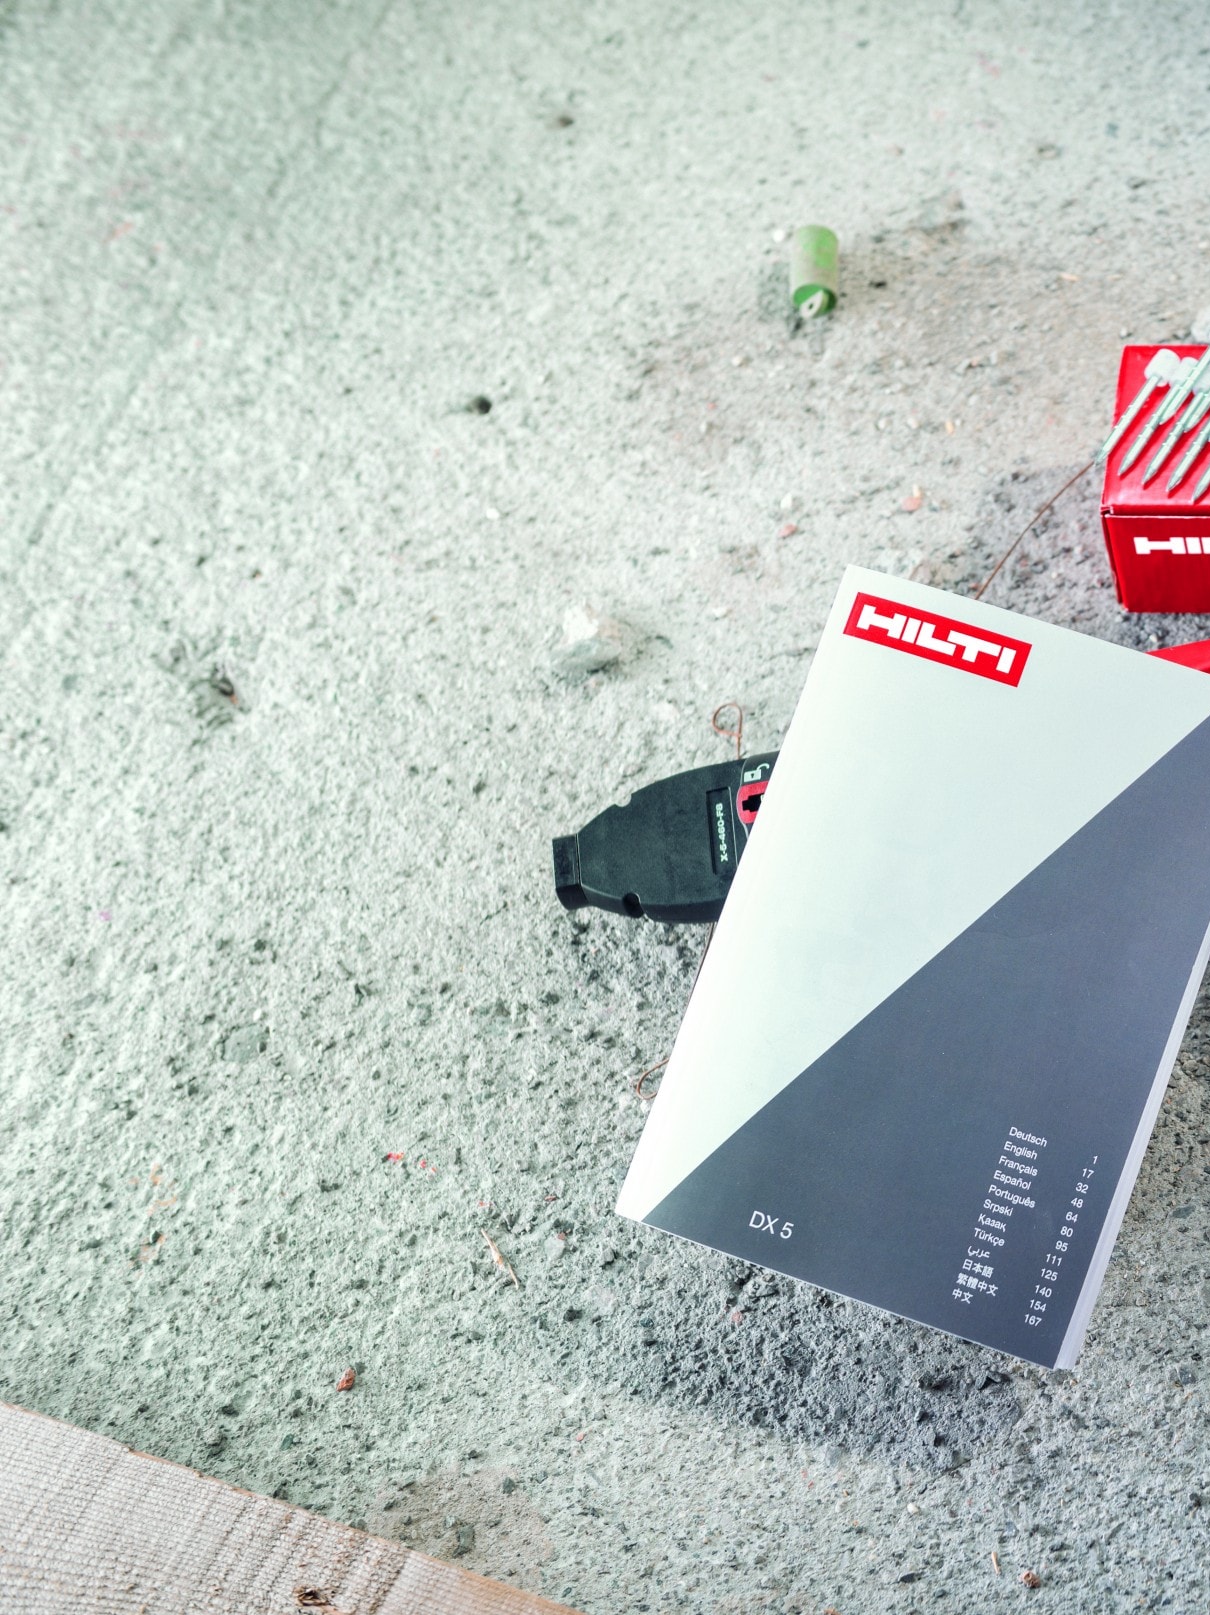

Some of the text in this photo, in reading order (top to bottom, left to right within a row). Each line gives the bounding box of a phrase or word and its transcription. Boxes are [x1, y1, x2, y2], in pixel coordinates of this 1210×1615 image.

[856, 604, 1017, 674] HILTI
[1003, 1141, 1095, 1179] English 17
[1009, 1126, 1099, 1165] Deutsch 1
[993, 1170, 1084, 1208] Español 48
[998, 1155, 1089, 1194] Français 32
[983, 1198, 1074, 1237] Srpski 80
[988, 1184, 1078, 1223] Português 64
[748, 1210, 795, 1239] DX 5
[974, 1228, 1063, 1267] Türkçe 111
[1055, 1240, 1069, 1252] 95
[962, 1258, 1052, 1298] 日本語 140
[1040, 1268, 1058, 1281] 125
[951, 1287, 1043, 1327] 中文 167
[1029, 1299, 1047, 1312] 154
